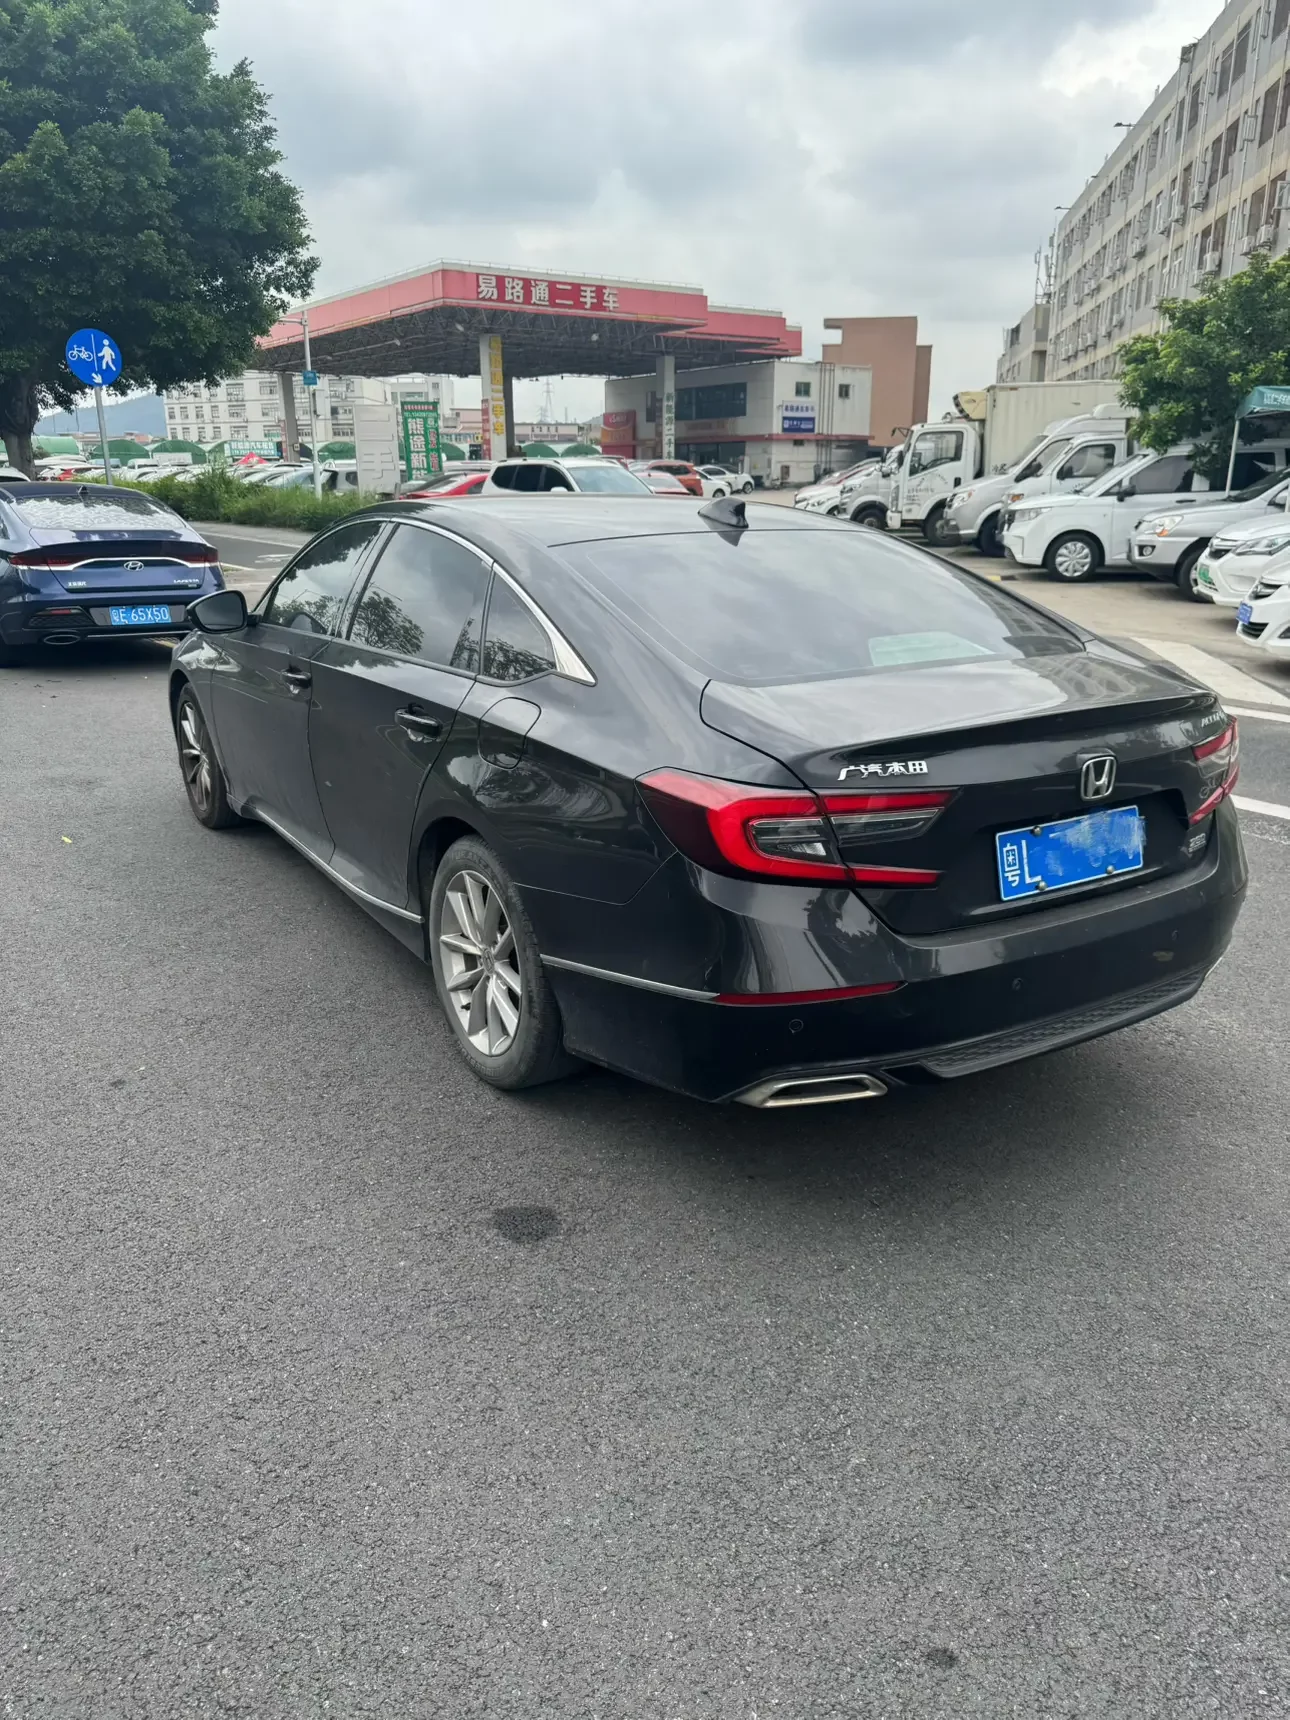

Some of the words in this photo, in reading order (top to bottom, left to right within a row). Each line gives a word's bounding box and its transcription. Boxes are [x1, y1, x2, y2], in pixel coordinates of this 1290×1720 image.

[478, 275, 619, 310] 易路通二手车
[838, 761, 928, 780] 广汽本田
